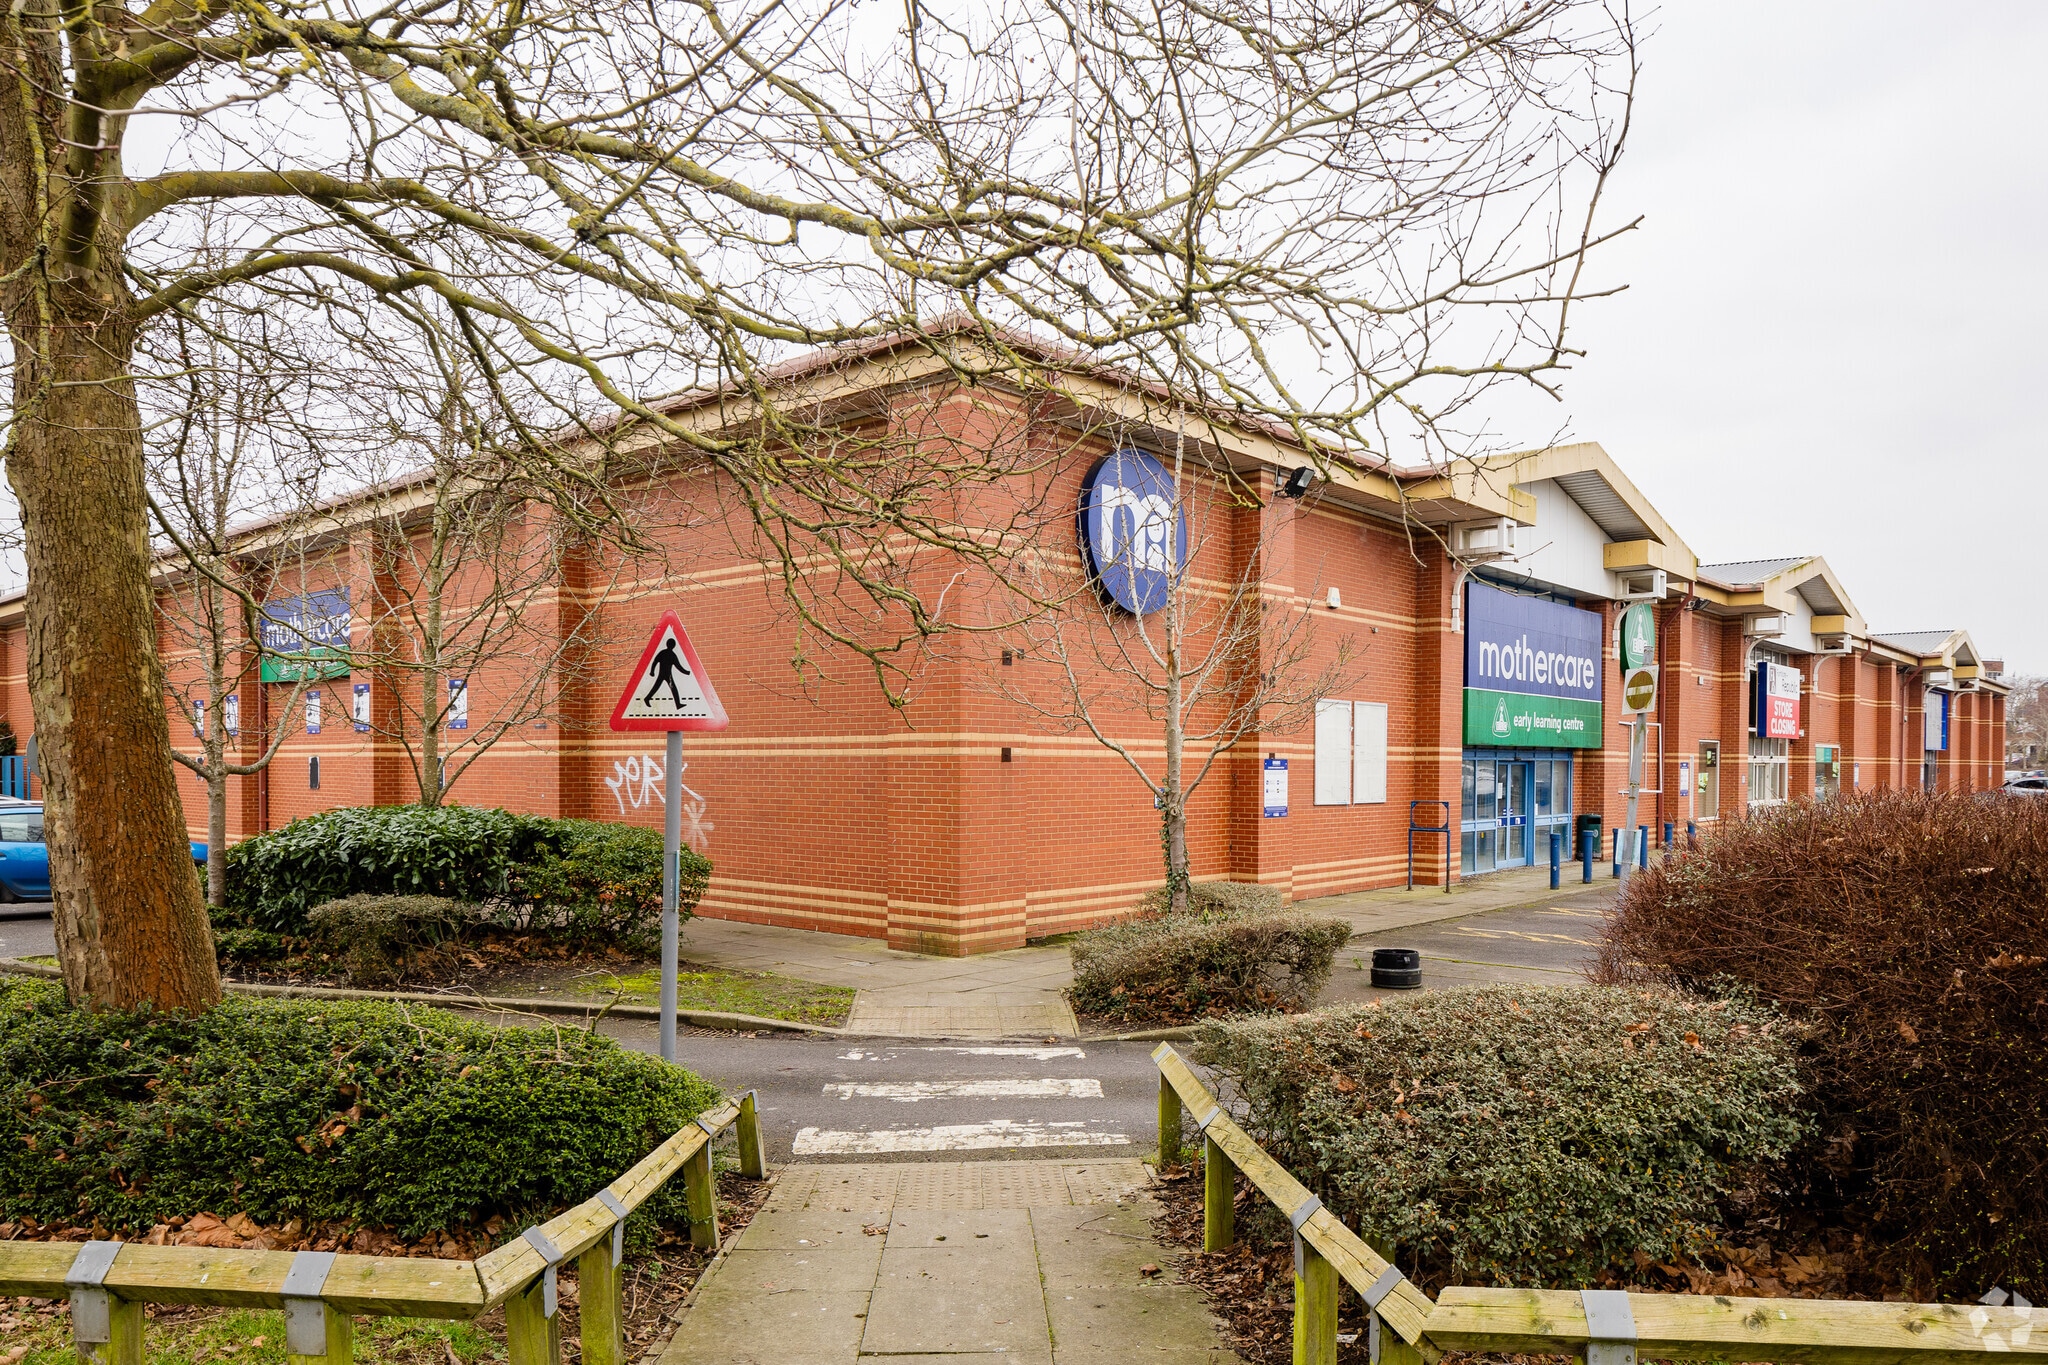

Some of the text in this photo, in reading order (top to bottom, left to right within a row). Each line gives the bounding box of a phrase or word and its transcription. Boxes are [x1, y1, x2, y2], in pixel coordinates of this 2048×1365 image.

[1479, 634, 1595, 690] mothercare
[1774, 700, 1793, 718] STORE
[1513, 711, 1584, 734] early learning centre
[1770, 717, 1796, 736] CLOSING
